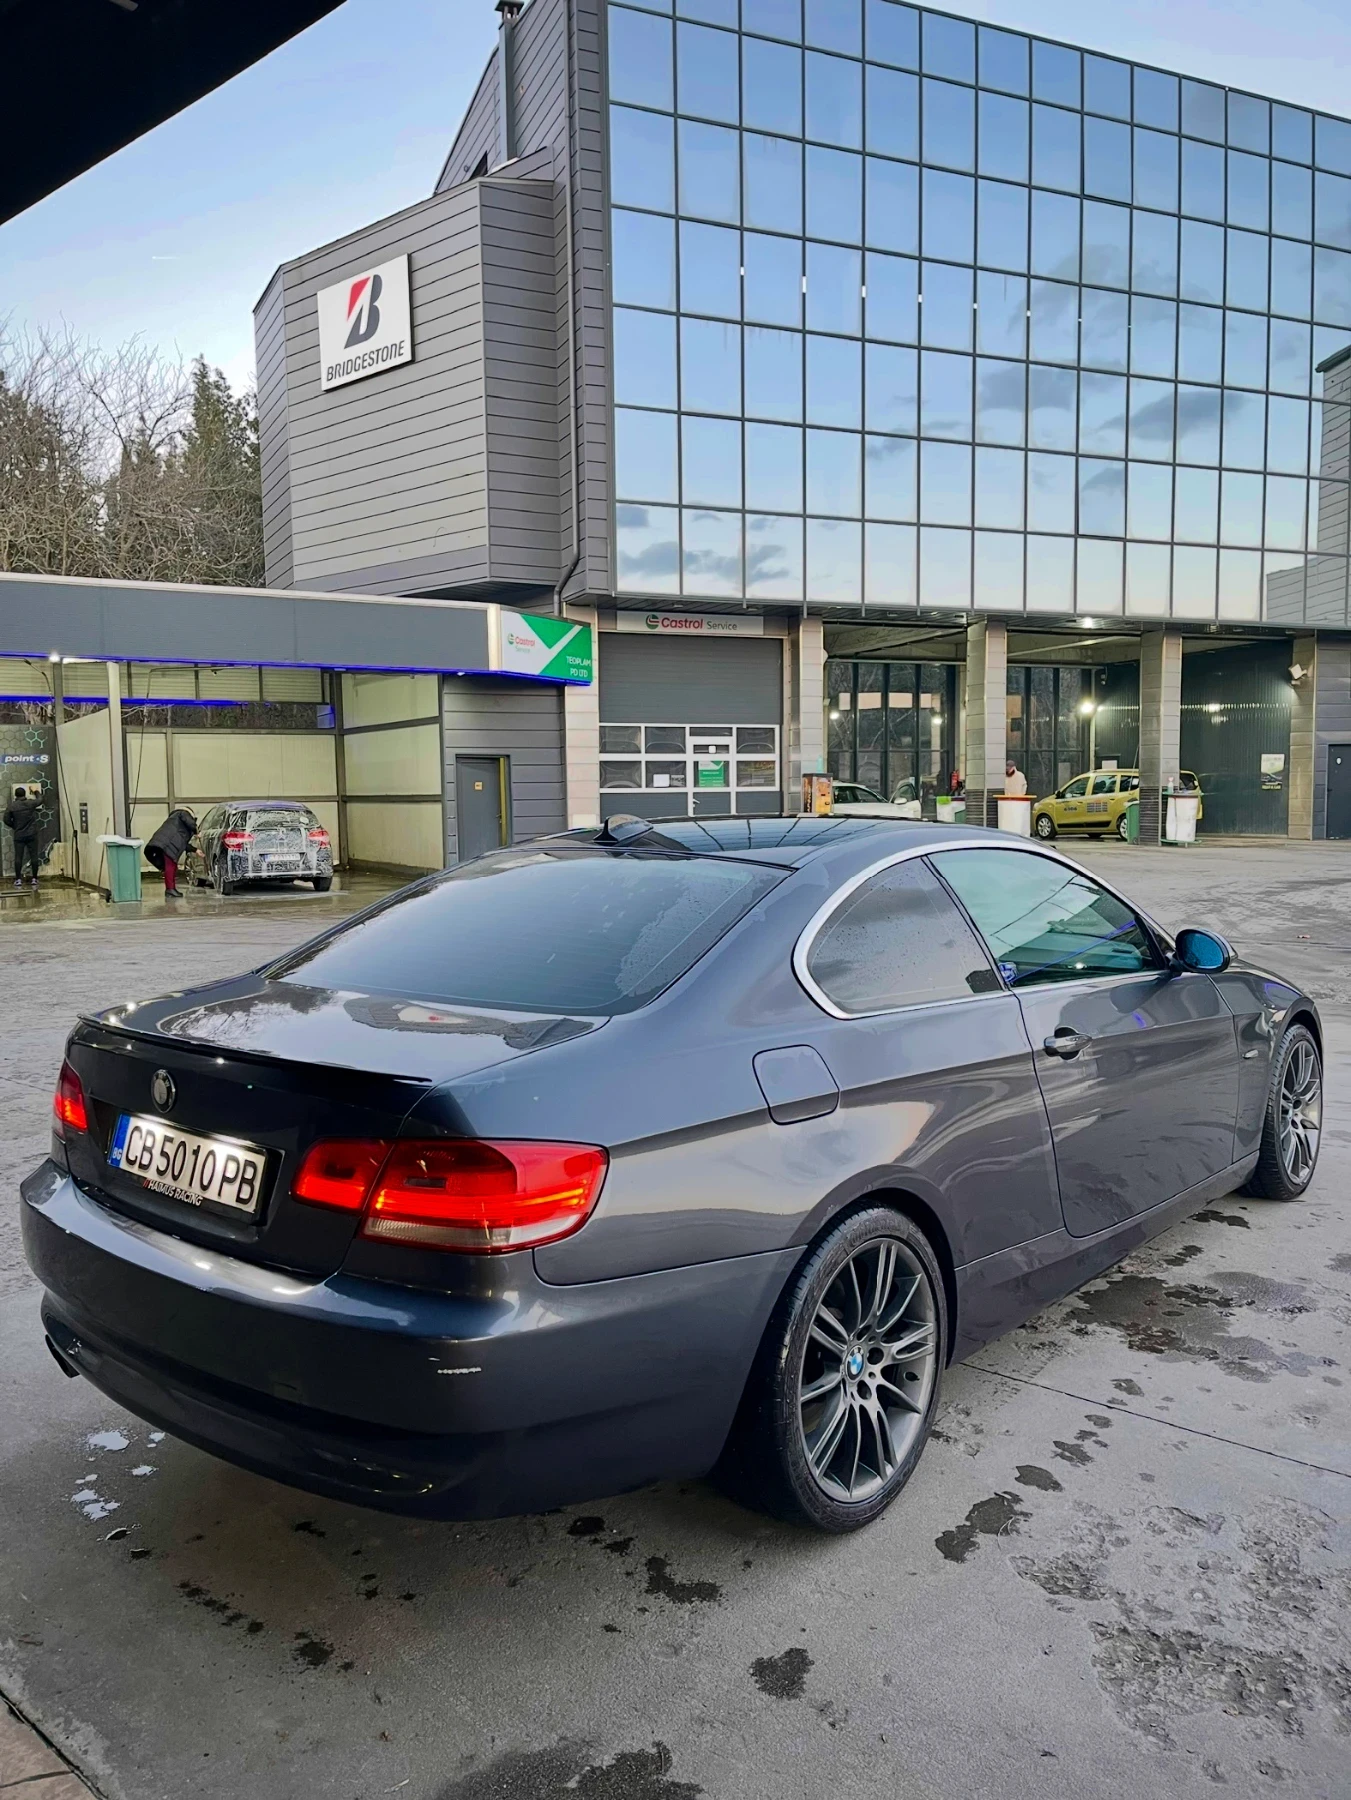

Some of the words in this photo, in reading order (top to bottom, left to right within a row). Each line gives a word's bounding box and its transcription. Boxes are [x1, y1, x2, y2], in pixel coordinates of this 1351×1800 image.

[326, 340, 405, 382] BRIDGESTONE
[661, 617, 704, 629] Castrol
[706, 620, 738, 630] Service
[515, 636, 535, 647] Castrol
[5, 755, 34, 763] point
[112, 1147, 122, 1161] BG
[174, 1188, 204, 1206] RACING
